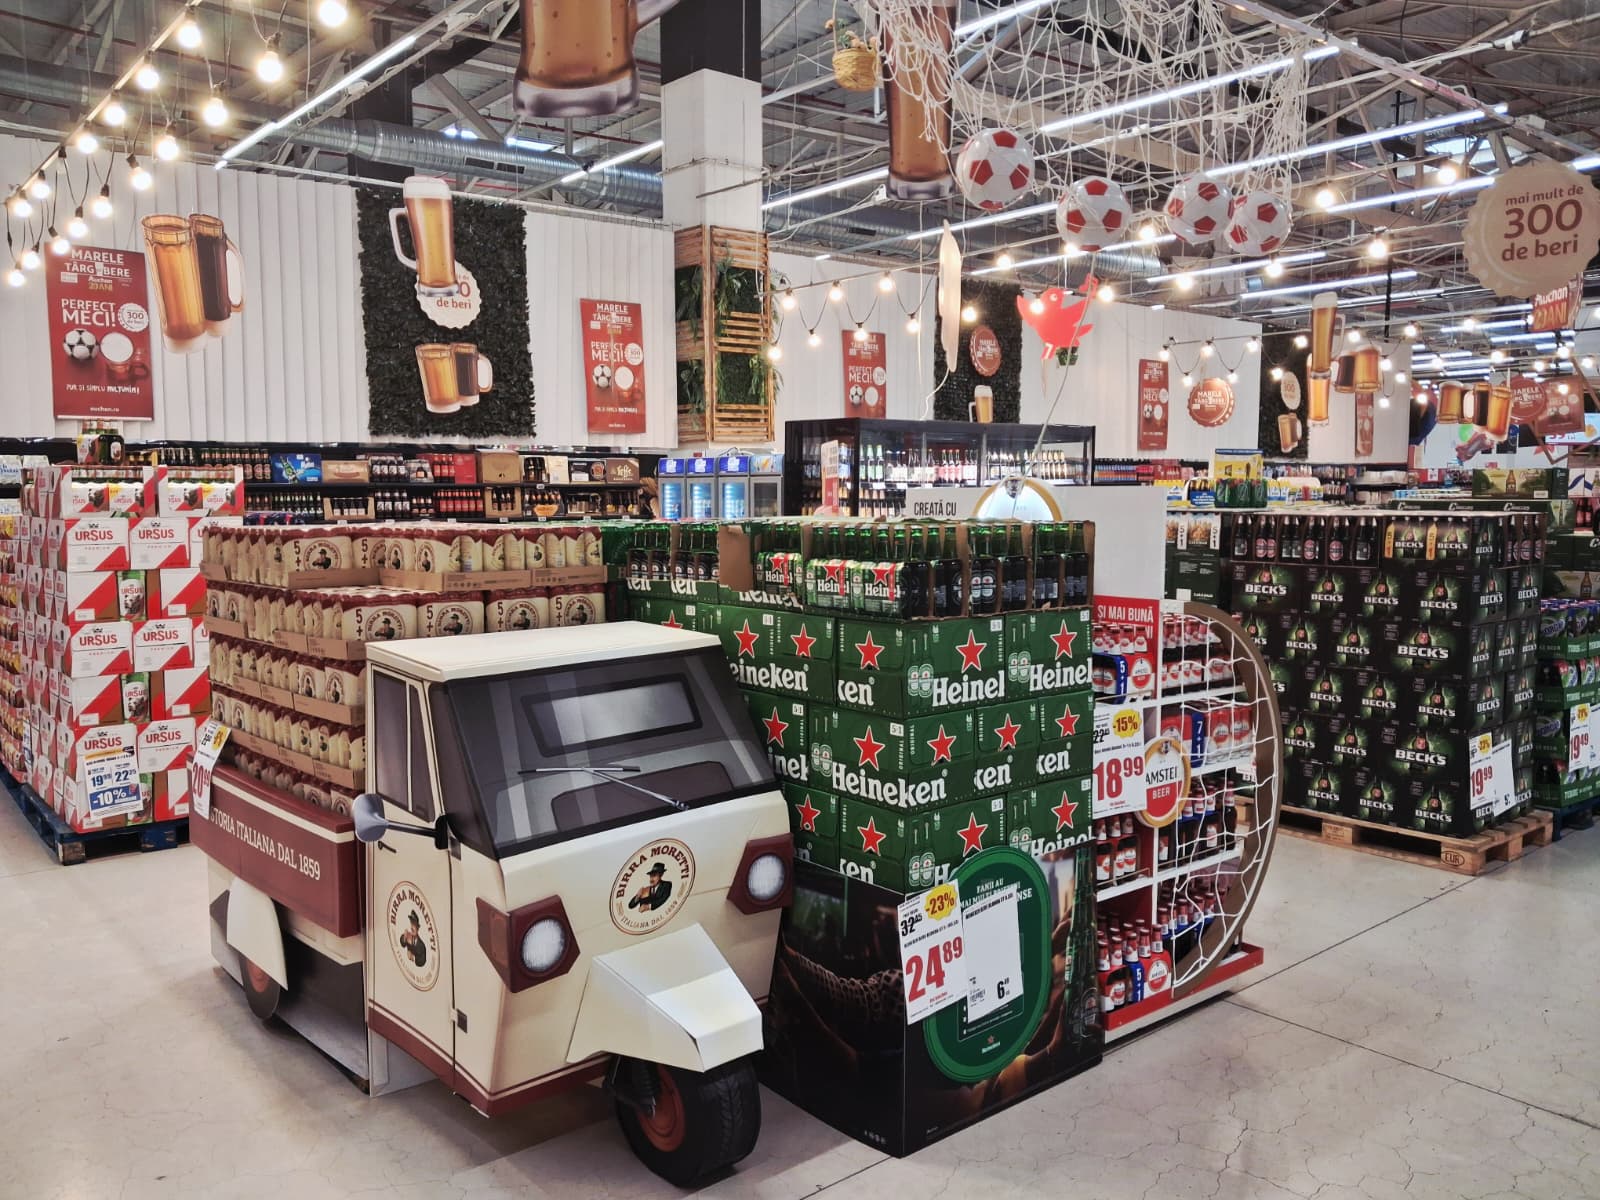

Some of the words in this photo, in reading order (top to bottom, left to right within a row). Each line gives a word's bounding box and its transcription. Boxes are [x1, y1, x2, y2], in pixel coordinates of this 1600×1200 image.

[1505, 192, 1530, 206] mai
[1533, 187, 1563, 202] mult
[1567, 184, 1584, 196] de
[1504, 199, 1583, 239] 300
[1501, 243, 1528, 261] de
[1534, 234, 1579, 258] beri
[71, 249, 124, 265] MARELE
[64, 261, 95, 274] TÂRG
[103, 266, 131, 278] BERE
[61, 298, 116, 312] PERFECT
[436, 297, 449, 308] de
[451, 298, 472, 309] beri
[596, 303, 628, 313] MARELE
[62, 309, 116, 327] MECI!
[126, 311, 144, 320] 300
[914, 500, 943, 516] CREATĂ
[946, 502, 957, 516] CU
[75, 529, 114, 541] URSUS
[138, 528, 175, 540] URSUS
[1438, 542, 1468, 550] BECK'S
[1244, 584, 1287, 595] BECK'S
[1517, 587, 1538, 600] BECK'S
[1311, 593, 1343, 602] BECK'S
[1364, 596, 1399, 605] BECK'S
[1480, 592, 1503, 605] BECK'S
[1420, 600, 1458, 609] BECK'S
[1108, 606, 1126, 620] MAI
[1128, 606, 1154, 623] BUNĂ
[79, 634, 118, 646] URSUS
[143, 630, 179, 642] URSUS
[1286, 641, 1318, 650] BECK'S
[1337, 645, 1370, 655] BECK'S
[1397, 645, 1449, 659] BECK'S
[729, 659, 808, 692] eineken
[1310, 692, 1342, 702] BECK'S
[1362, 699, 1396, 709] BECK'S
[1477, 698, 1500, 712] BECK'S
[1418, 705, 1455, 717] BECK'S
[1113, 715, 1138, 733] -15%
[84, 737, 122, 750] URSUS
[145, 731, 181, 744] URSUS
[1284, 737, 1315, 749] BECK'S
[1334, 745, 1367, 757] BECK'S
[1394, 749, 1447, 766] BECK'S
[832, 762, 947, 809] Heineken
[93, 788, 127, 806] -10%
[1152, 786, 1171, 799] BEER
[1308, 789, 1340, 801] BECK'S
[1359, 798, 1394, 811] BECK'S
[1415, 809, 1453, 823] BECK'S
[211, 808, 236, 836] STORIA
[236, 820, 276, 859] ITALIANA
[277, 843, 297, 869] DAL
[299, 853, 321, 881] 1859
[1445, 853, 1460, 865] EUR
[616, 854, 648, 899] BIRRA
[650, 845, 690, 880] MORETTI
[925, 891, 956, 917] -23%
[390, 889, 408, 926] BIRRA
[408, 889, 437, 953] MORETTI
